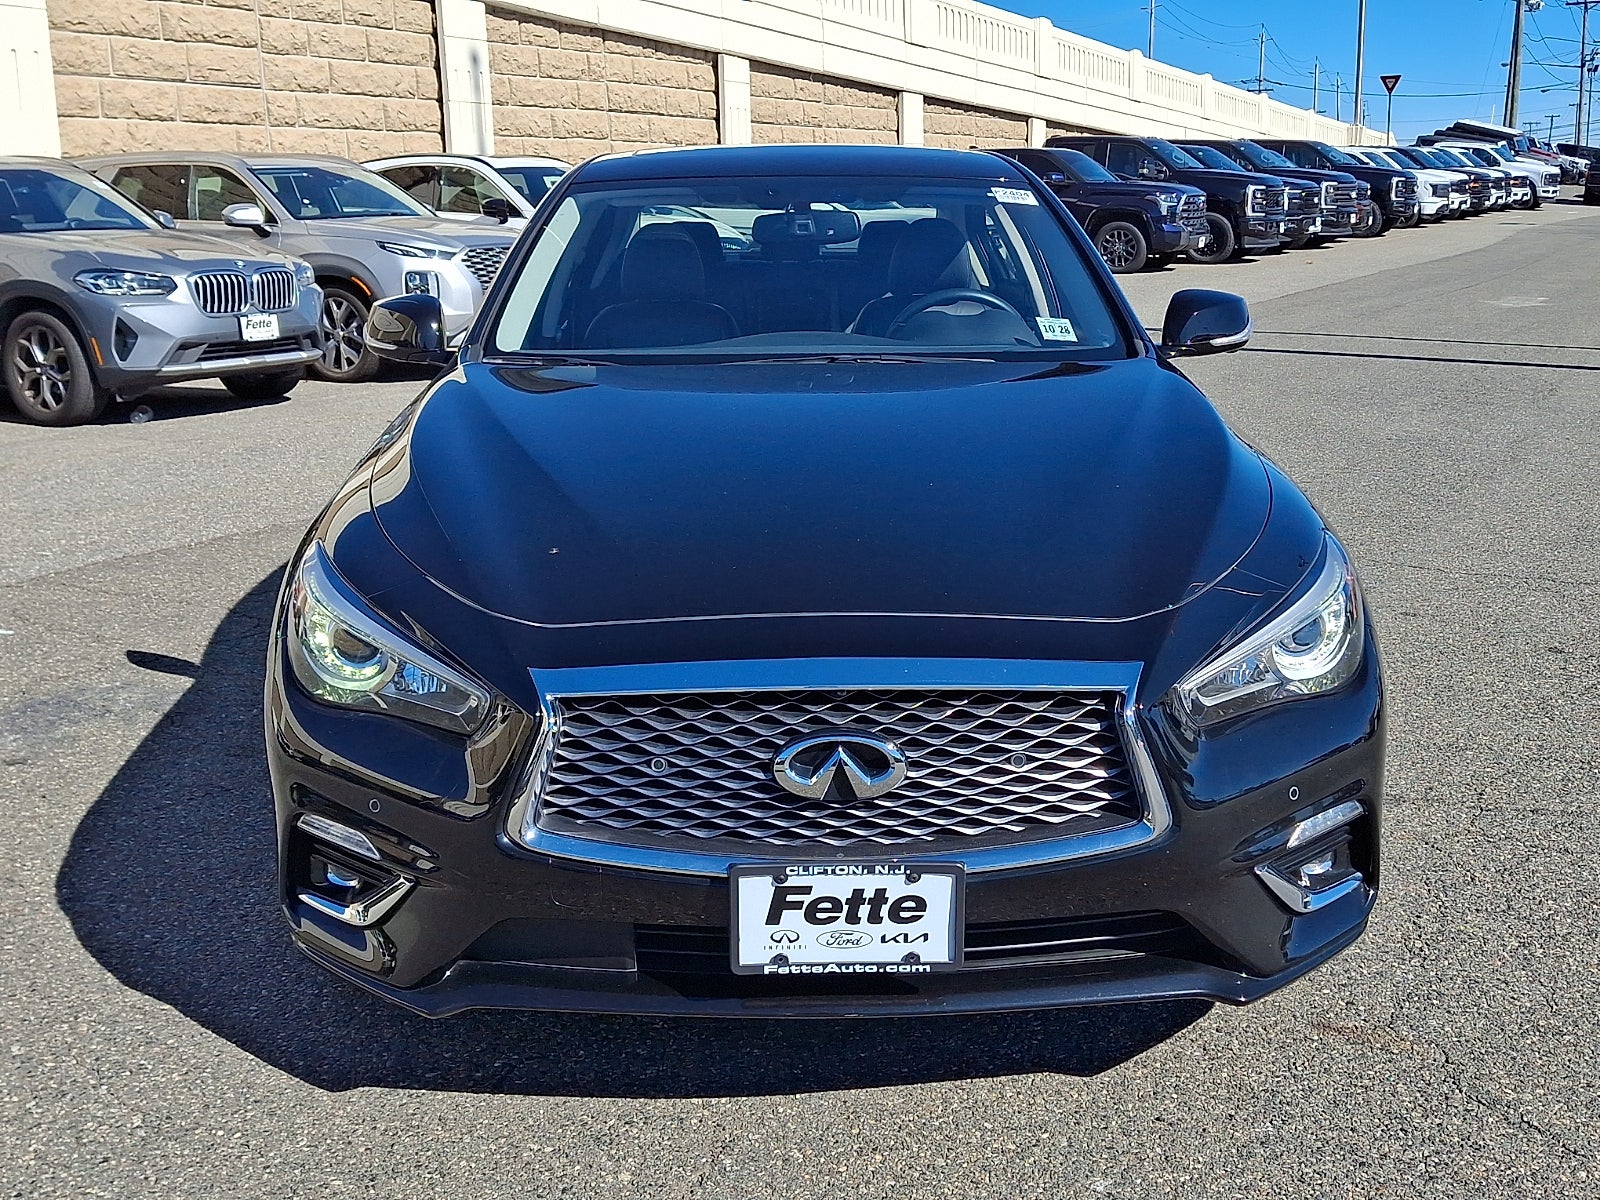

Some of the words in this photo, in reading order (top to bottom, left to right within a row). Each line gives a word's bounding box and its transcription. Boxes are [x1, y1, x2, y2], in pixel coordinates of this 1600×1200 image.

[246, 319, 272, 330] Fette
[1042, 324, 1055, 333] 10
[1057, 325, 1071, 335] 28
[785, 865, 868, 876] CLIFTON,
[875, 864, 911, 875] N.J.
[765, 885, 928, 926] Fette
[826, 932, 863, 947] Ford
[763, 963, 931, 975] FetteAuto.com
